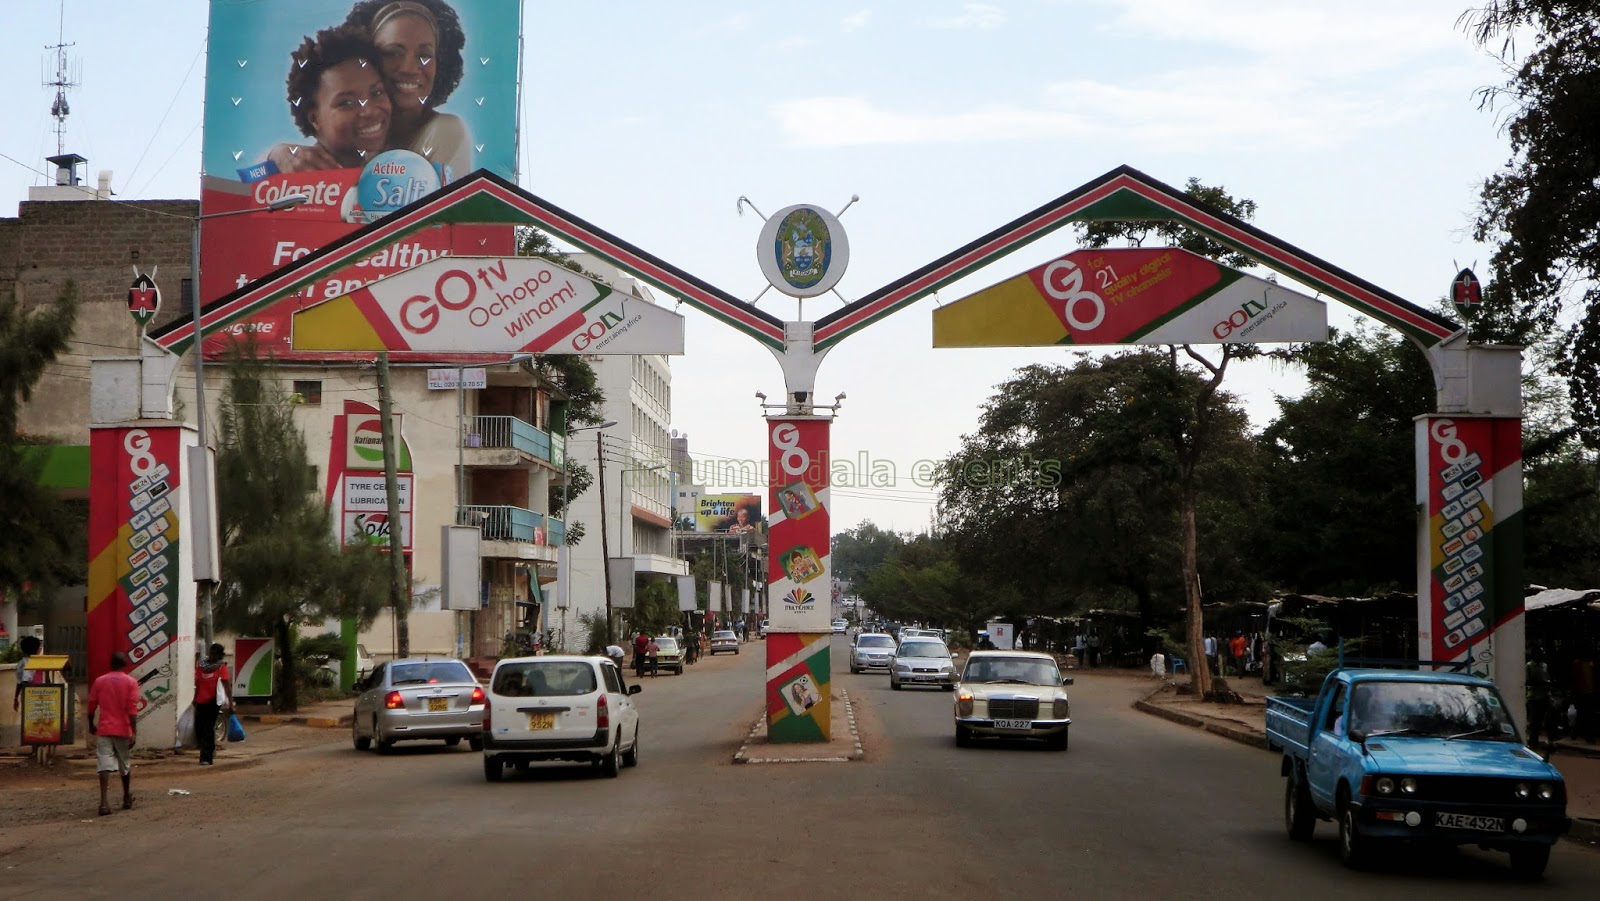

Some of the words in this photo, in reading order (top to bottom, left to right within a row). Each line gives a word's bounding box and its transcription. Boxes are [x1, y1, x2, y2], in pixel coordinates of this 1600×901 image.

[249, 166, 267, 179] NEW
[373, 161, 406, 175] Active
[372, 177, 425, 208] Salt
[354, 243, 449, 267] alth
[1095, 265, 1119, 289] 21
[1104, 272, 1138, 296] quality
[1140, 252, 1172, 276] digital
[469, 269, 552, 328] Ochopo
[504, 280, 577, 338] winam!
[1043, 259, 1106, 331] GO
[595, 326, 628, 350] entertaining
[627, 314, 643, 329] africa
[1240, 312, 1273, 337] entertaining
[1272, 301, 1288, 315] africa
[124, 429, 157, 478] GO
[772, 423, 810, 476] GO
[1431, 419, 1467, 466] GO
[350, 483, 371, 491] TYRE
[373, 483, 406, 491] CERE
[350, 497, 405, 505] LUBRICAN
[701, 499, 735, 509] Brighten
[701, 509, 712, 517] up
[720, 507, 735, 517] life
[1436, 814, 1464, 828] KAE
[1469, 816, 1504, 831] 432N
